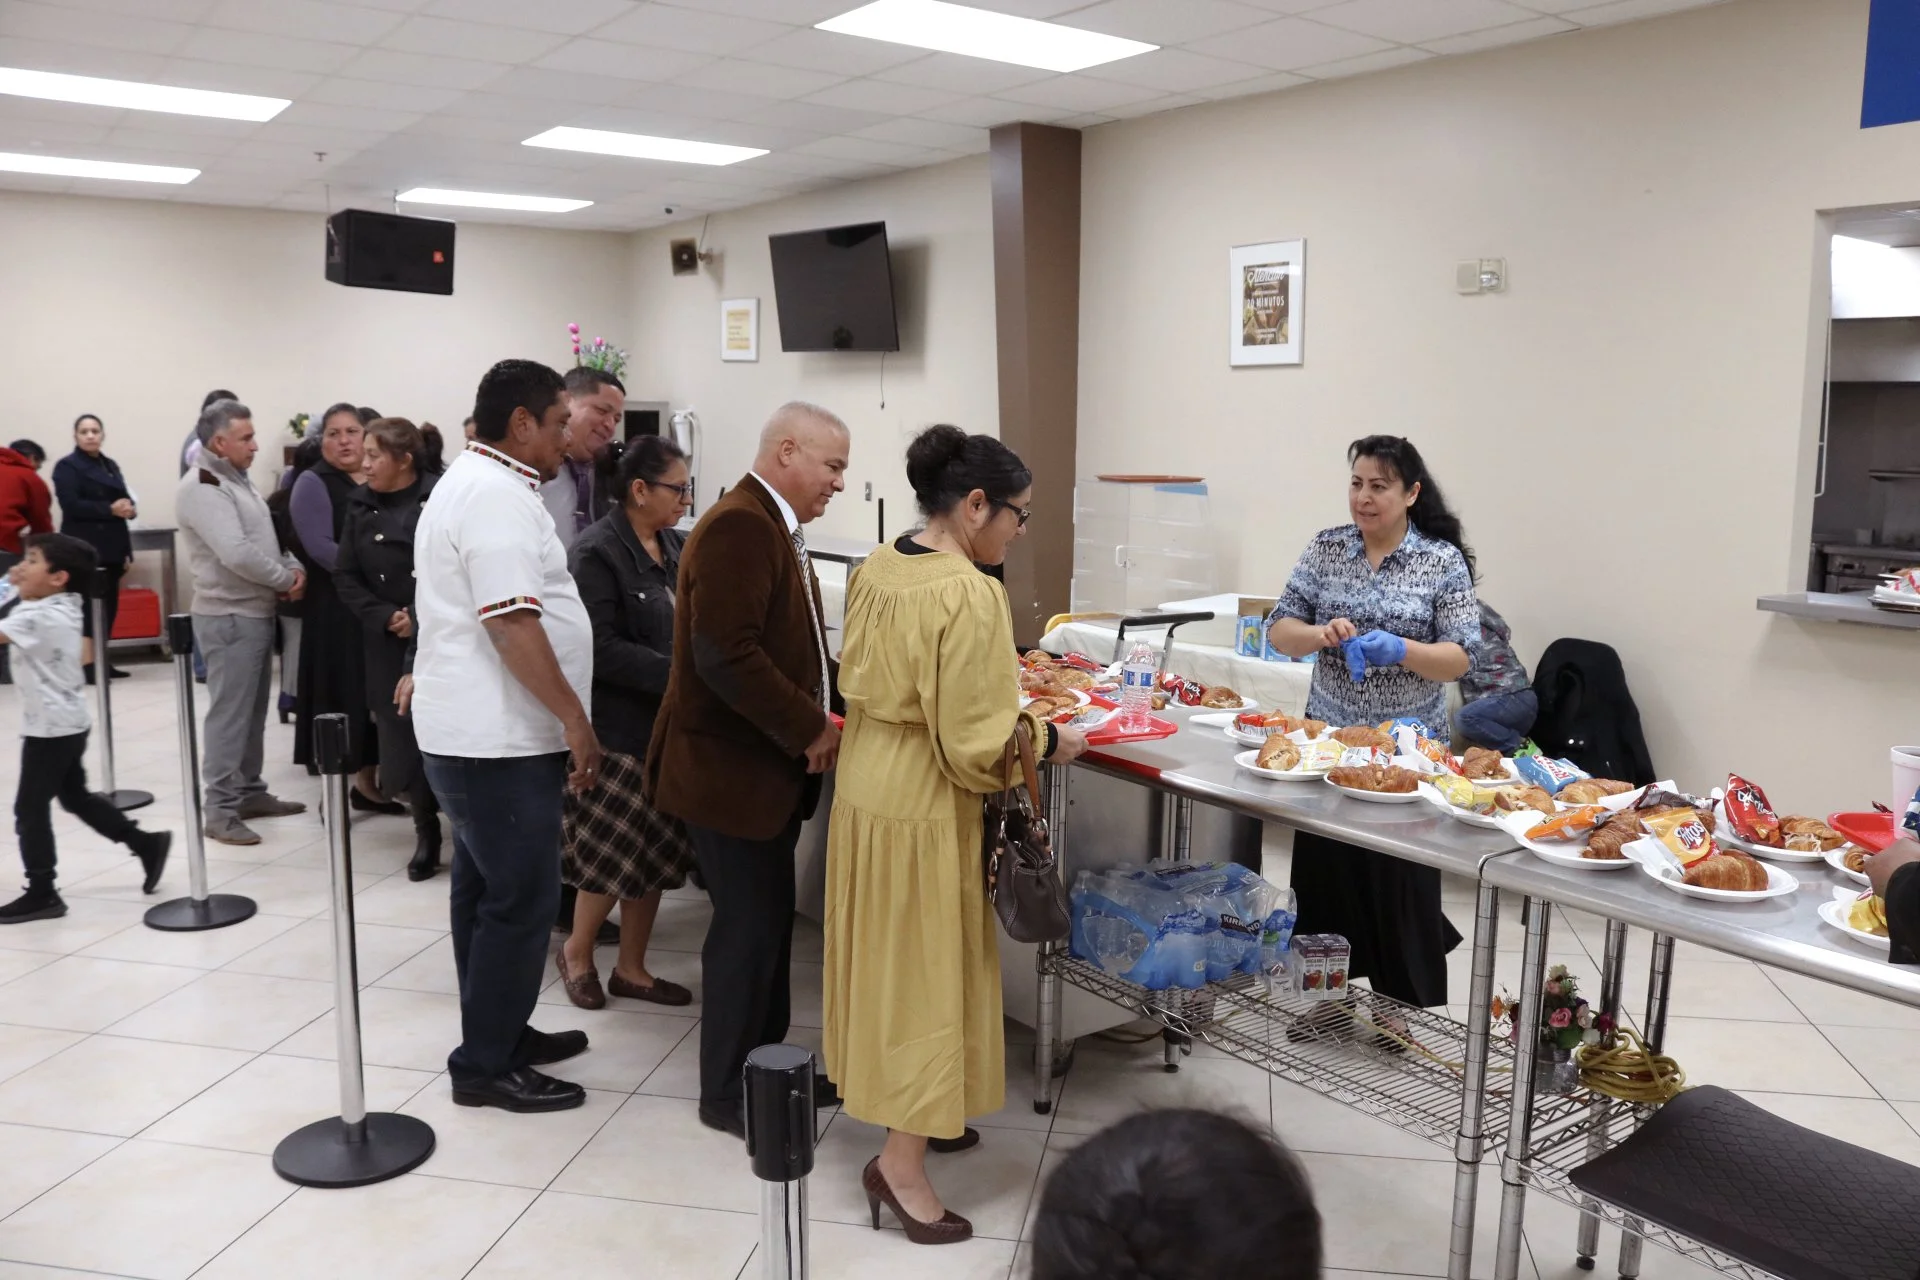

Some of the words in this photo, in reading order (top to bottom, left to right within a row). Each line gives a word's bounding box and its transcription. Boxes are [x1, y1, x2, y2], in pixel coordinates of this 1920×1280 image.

[1256, 296, 1285, 308] MINUTOS
[1673, 821, 1706, 849] Fritos
[1223, 915, 1260, 932] KIRKND
